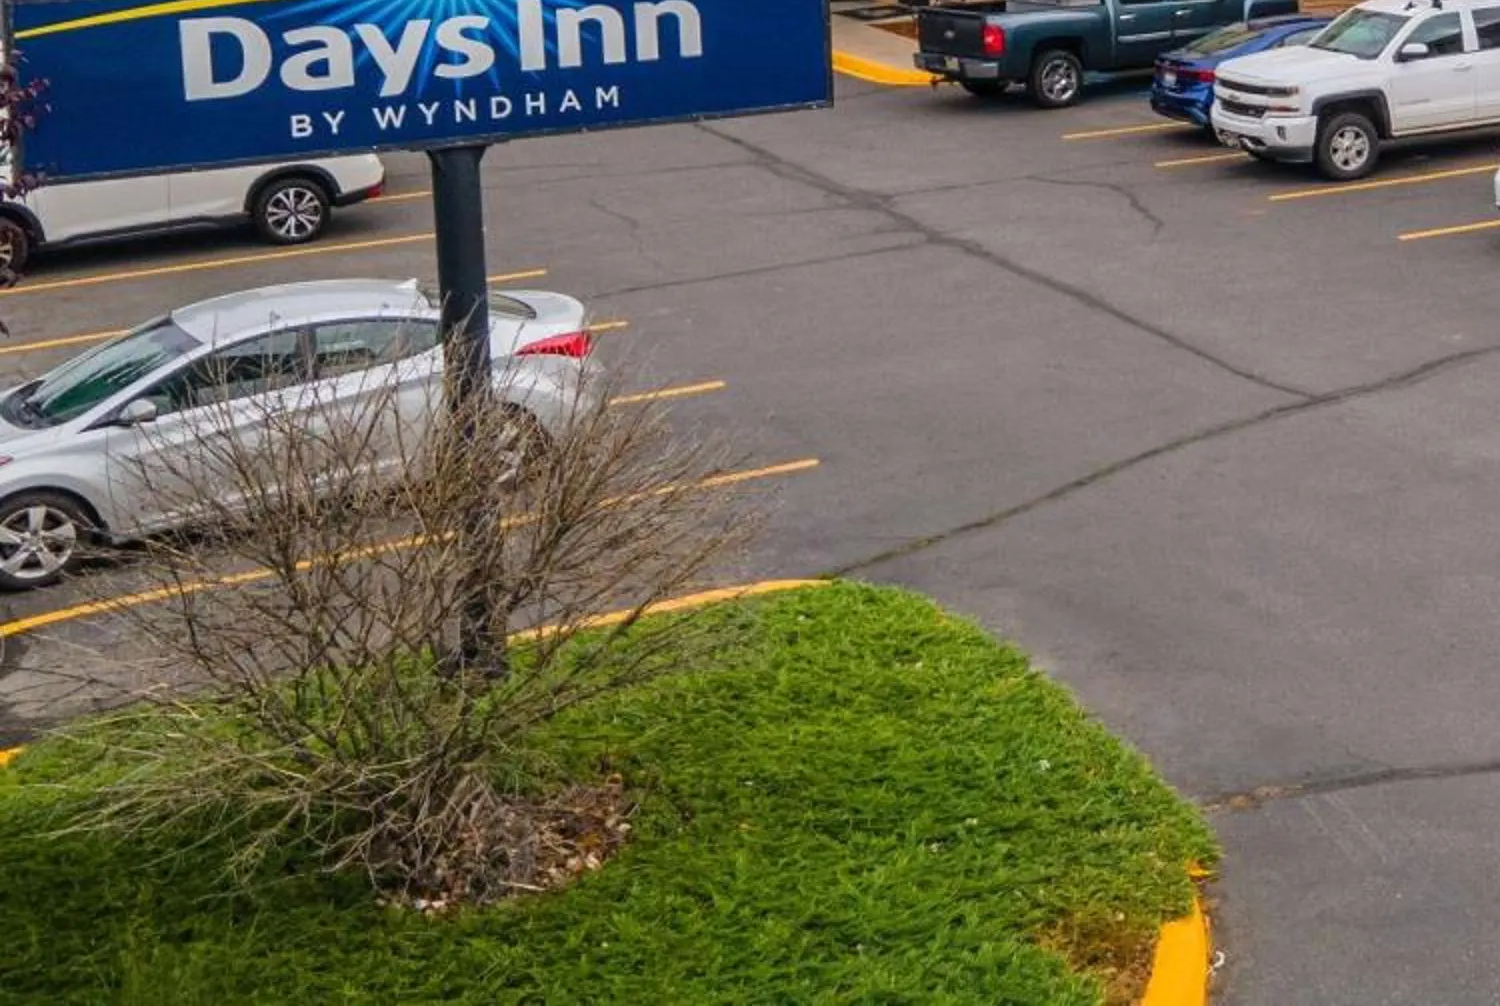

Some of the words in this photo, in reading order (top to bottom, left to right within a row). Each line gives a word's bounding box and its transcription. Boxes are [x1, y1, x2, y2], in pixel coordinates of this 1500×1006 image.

[179, 15, 495, 102] Days
[290, 110, 346, 139] BY
[372, 85, 620, 131] WYNDHAM
